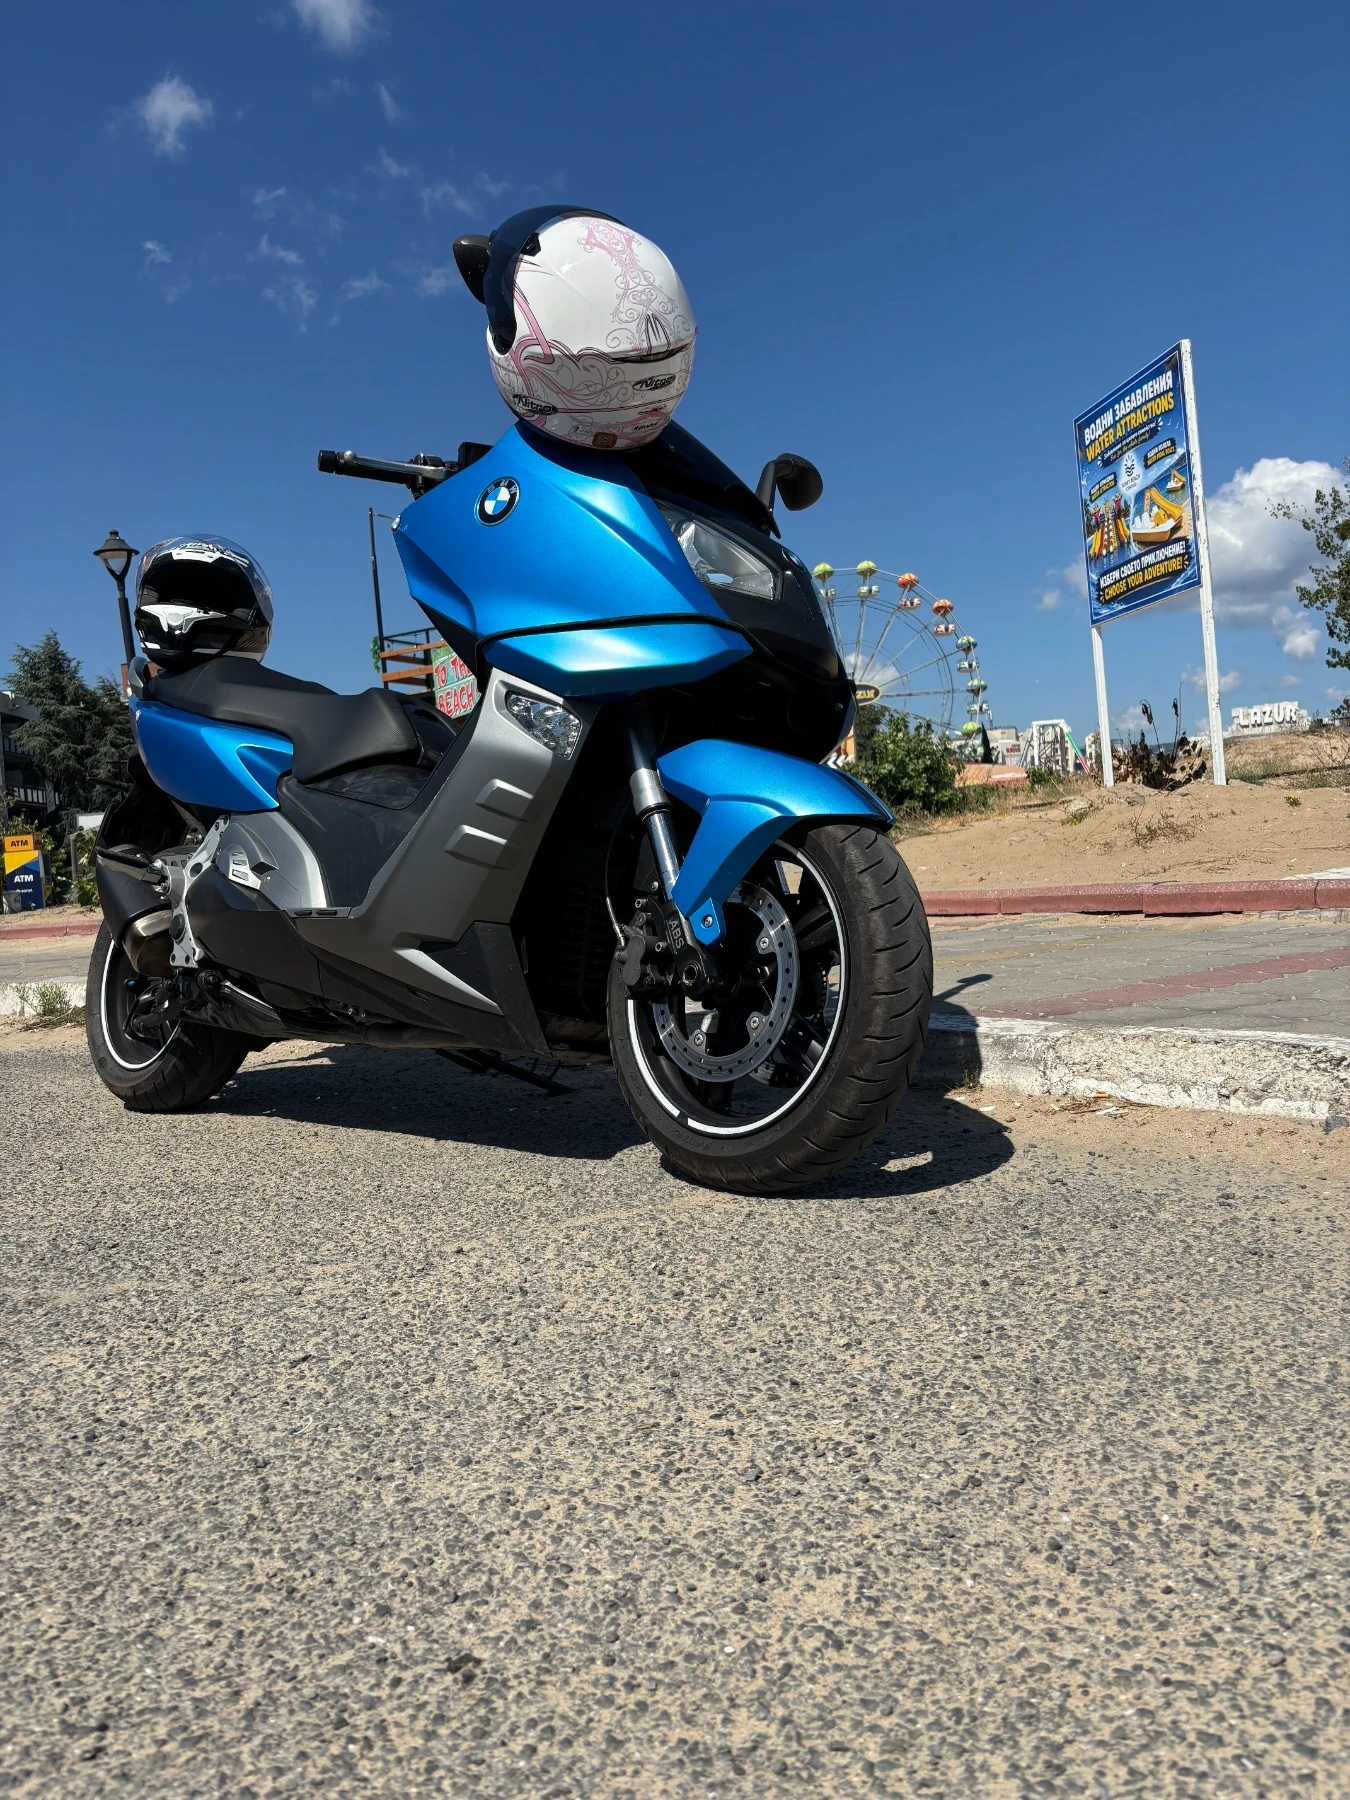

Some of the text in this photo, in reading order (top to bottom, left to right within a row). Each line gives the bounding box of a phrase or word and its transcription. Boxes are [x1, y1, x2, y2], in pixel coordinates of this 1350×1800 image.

[638, 375, 675, 391] Nitro
[514, 394, 554, 415] Nitro
[1084, 370, 1173, 446] ВОДНИ ЗАБАВЛЕНИЯ
[1086, 428, 1114, 463] WATER
[1116, 391, 1174, 439] ATTRACTIONS
[1100, 540, 1186, 589] ИЗБЕРИ СВОЕТО ПРИКЛЮЧЕНИЕ!
[1105, 556, 1183, 600] CHOOSE YOUR ADVENTURE!
[434, 655, 473, 689] TO TH
[438, 680, 475, 716] BEACH
[1238, 702, 1298, 727] LAZUR
[10, 839, 29, 847] ATM
[14, 874, 34, 883] ATM
[669, 919, 685, 949] ABS
